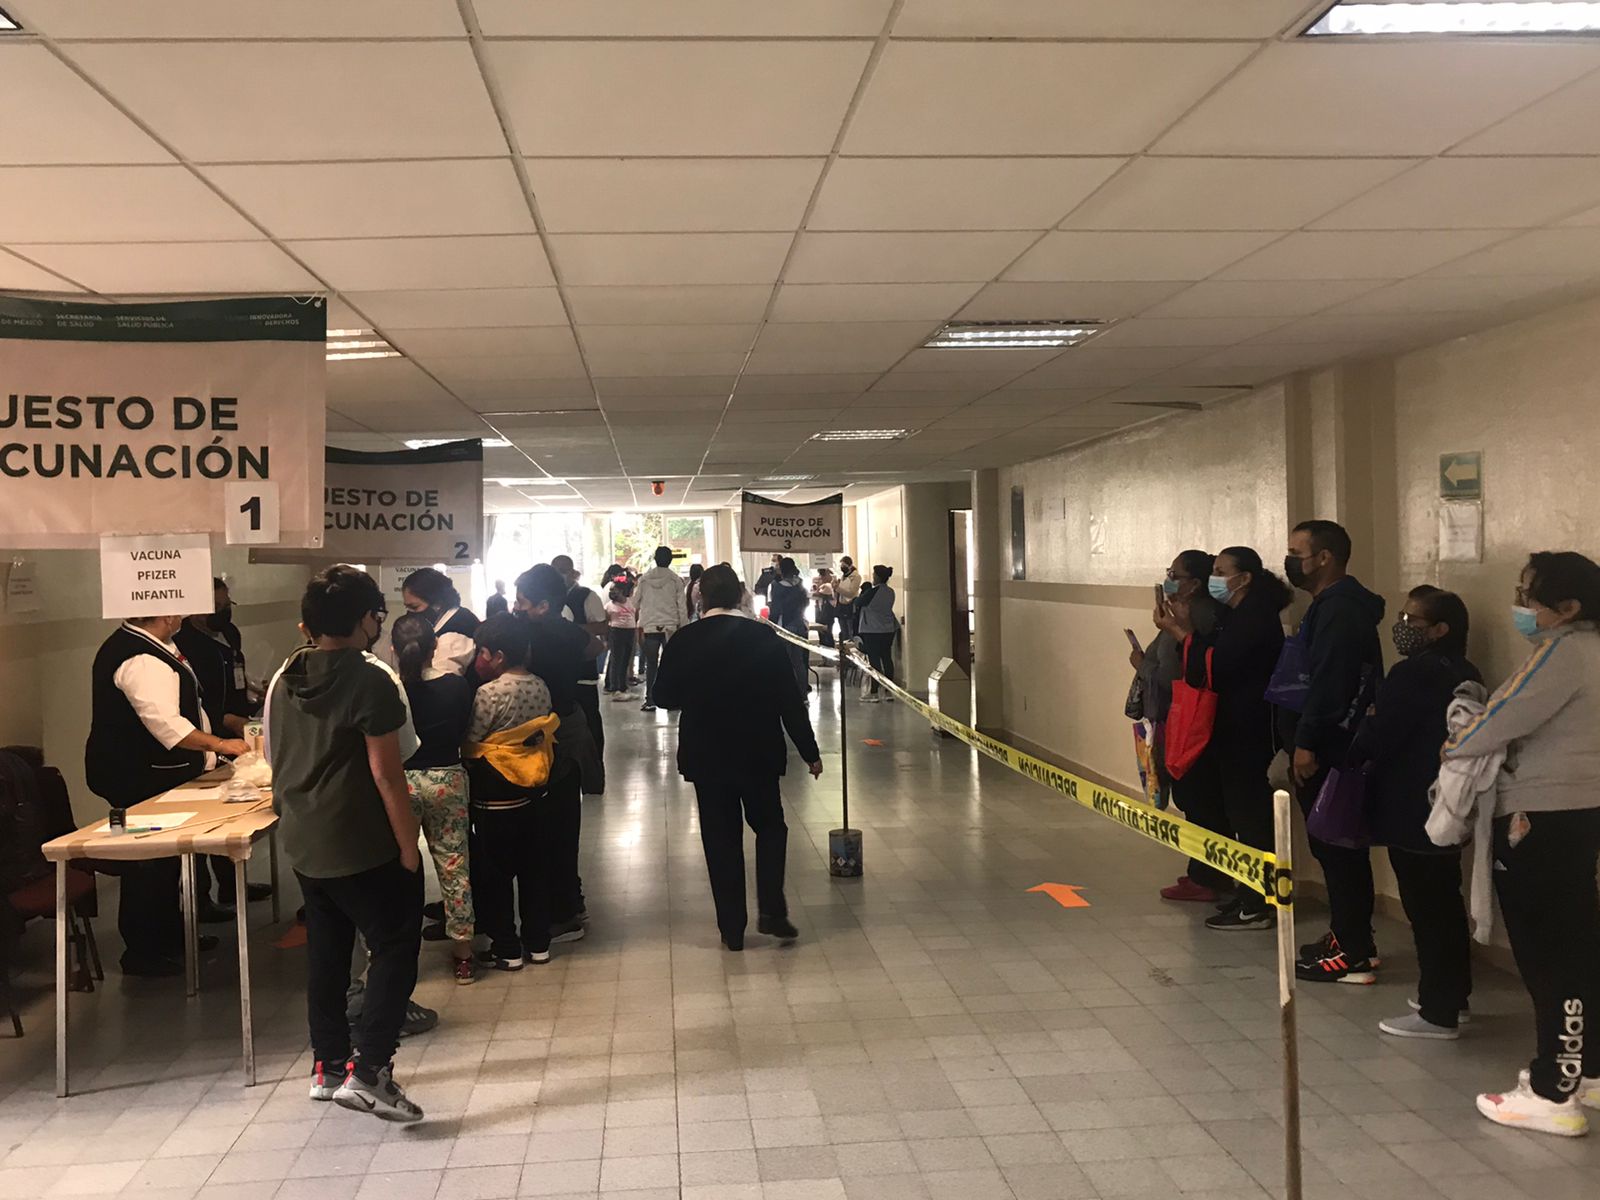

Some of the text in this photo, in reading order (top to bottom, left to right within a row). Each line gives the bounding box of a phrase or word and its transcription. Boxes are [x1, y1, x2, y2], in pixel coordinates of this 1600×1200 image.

[173, 396, 239, 431] DE
[0, 436, 270, 479] CUNACIÓN
[405, 489, 439, 507] DE
[239, 496, 262, 531] 1
[760, 516, 824, 527] PUESTO DE
[753, 527, 831, 538] VACUNACIÓN
[454, 541, 470, 559] 2
[783, 539, 792, 549] 3
[130, 549, 182, 562] VACUNA
[137, 569, 177, 581] PFIZER
[131, 589, 185, 602] INFANTIL
[1557, 998, 1584, 1092] adidas
